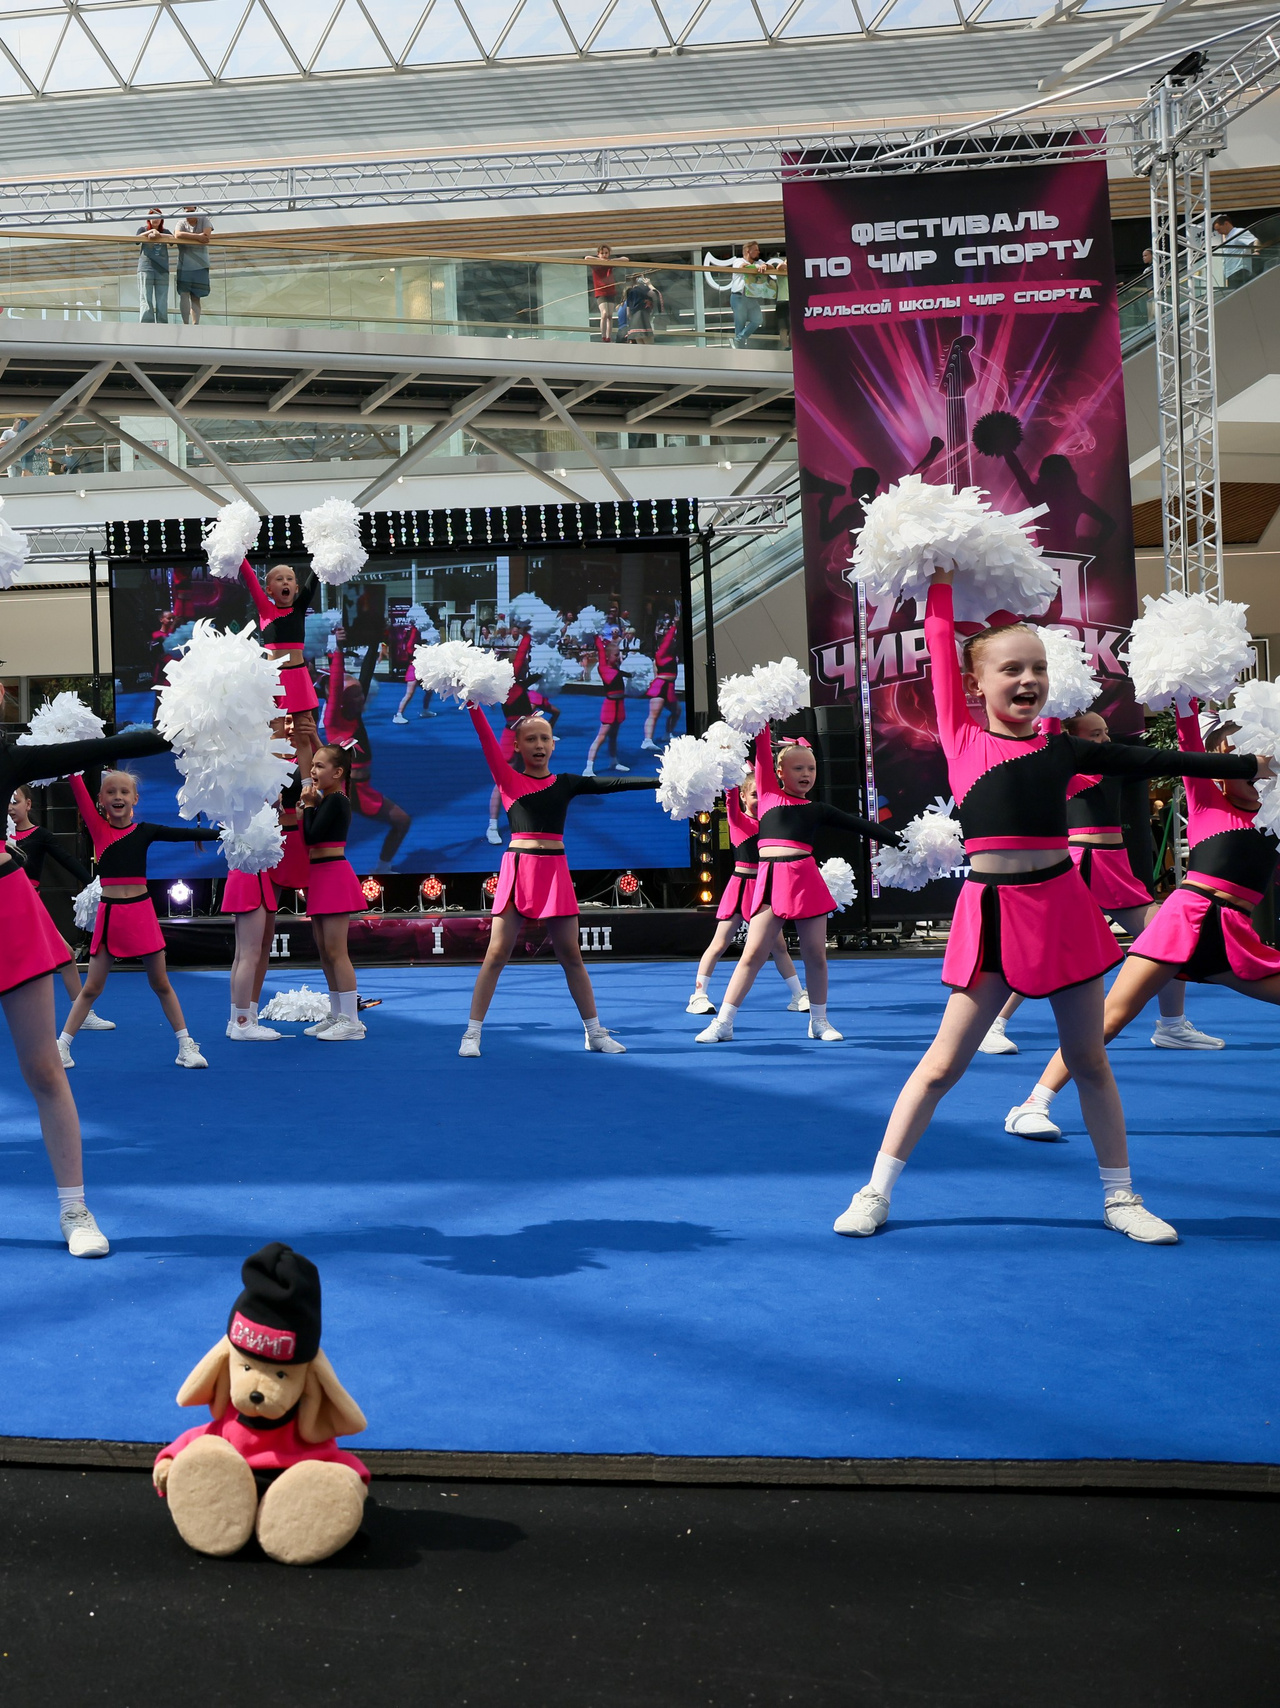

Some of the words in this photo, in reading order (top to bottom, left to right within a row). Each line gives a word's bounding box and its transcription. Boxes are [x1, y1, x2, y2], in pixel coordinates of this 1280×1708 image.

[851, 210, 1060, 246] ФЕСТИВАЛЬ
[804, 255, 852, 279] ПО
[867, 249, 938, 274] ЧИР
[954, 238, 1094, 268] СПОРТУ
[804, 298, 892, 318] УРАЛЬСКОЙ
[898, 295, 961, 313] ШКОЛЫ
[968, 291, 1006, 307] ЧИР
[1013, 286, 1093, 304] СПОРТА
[431, 926, 444, 955] I
[579, 926, 613, 951] III
